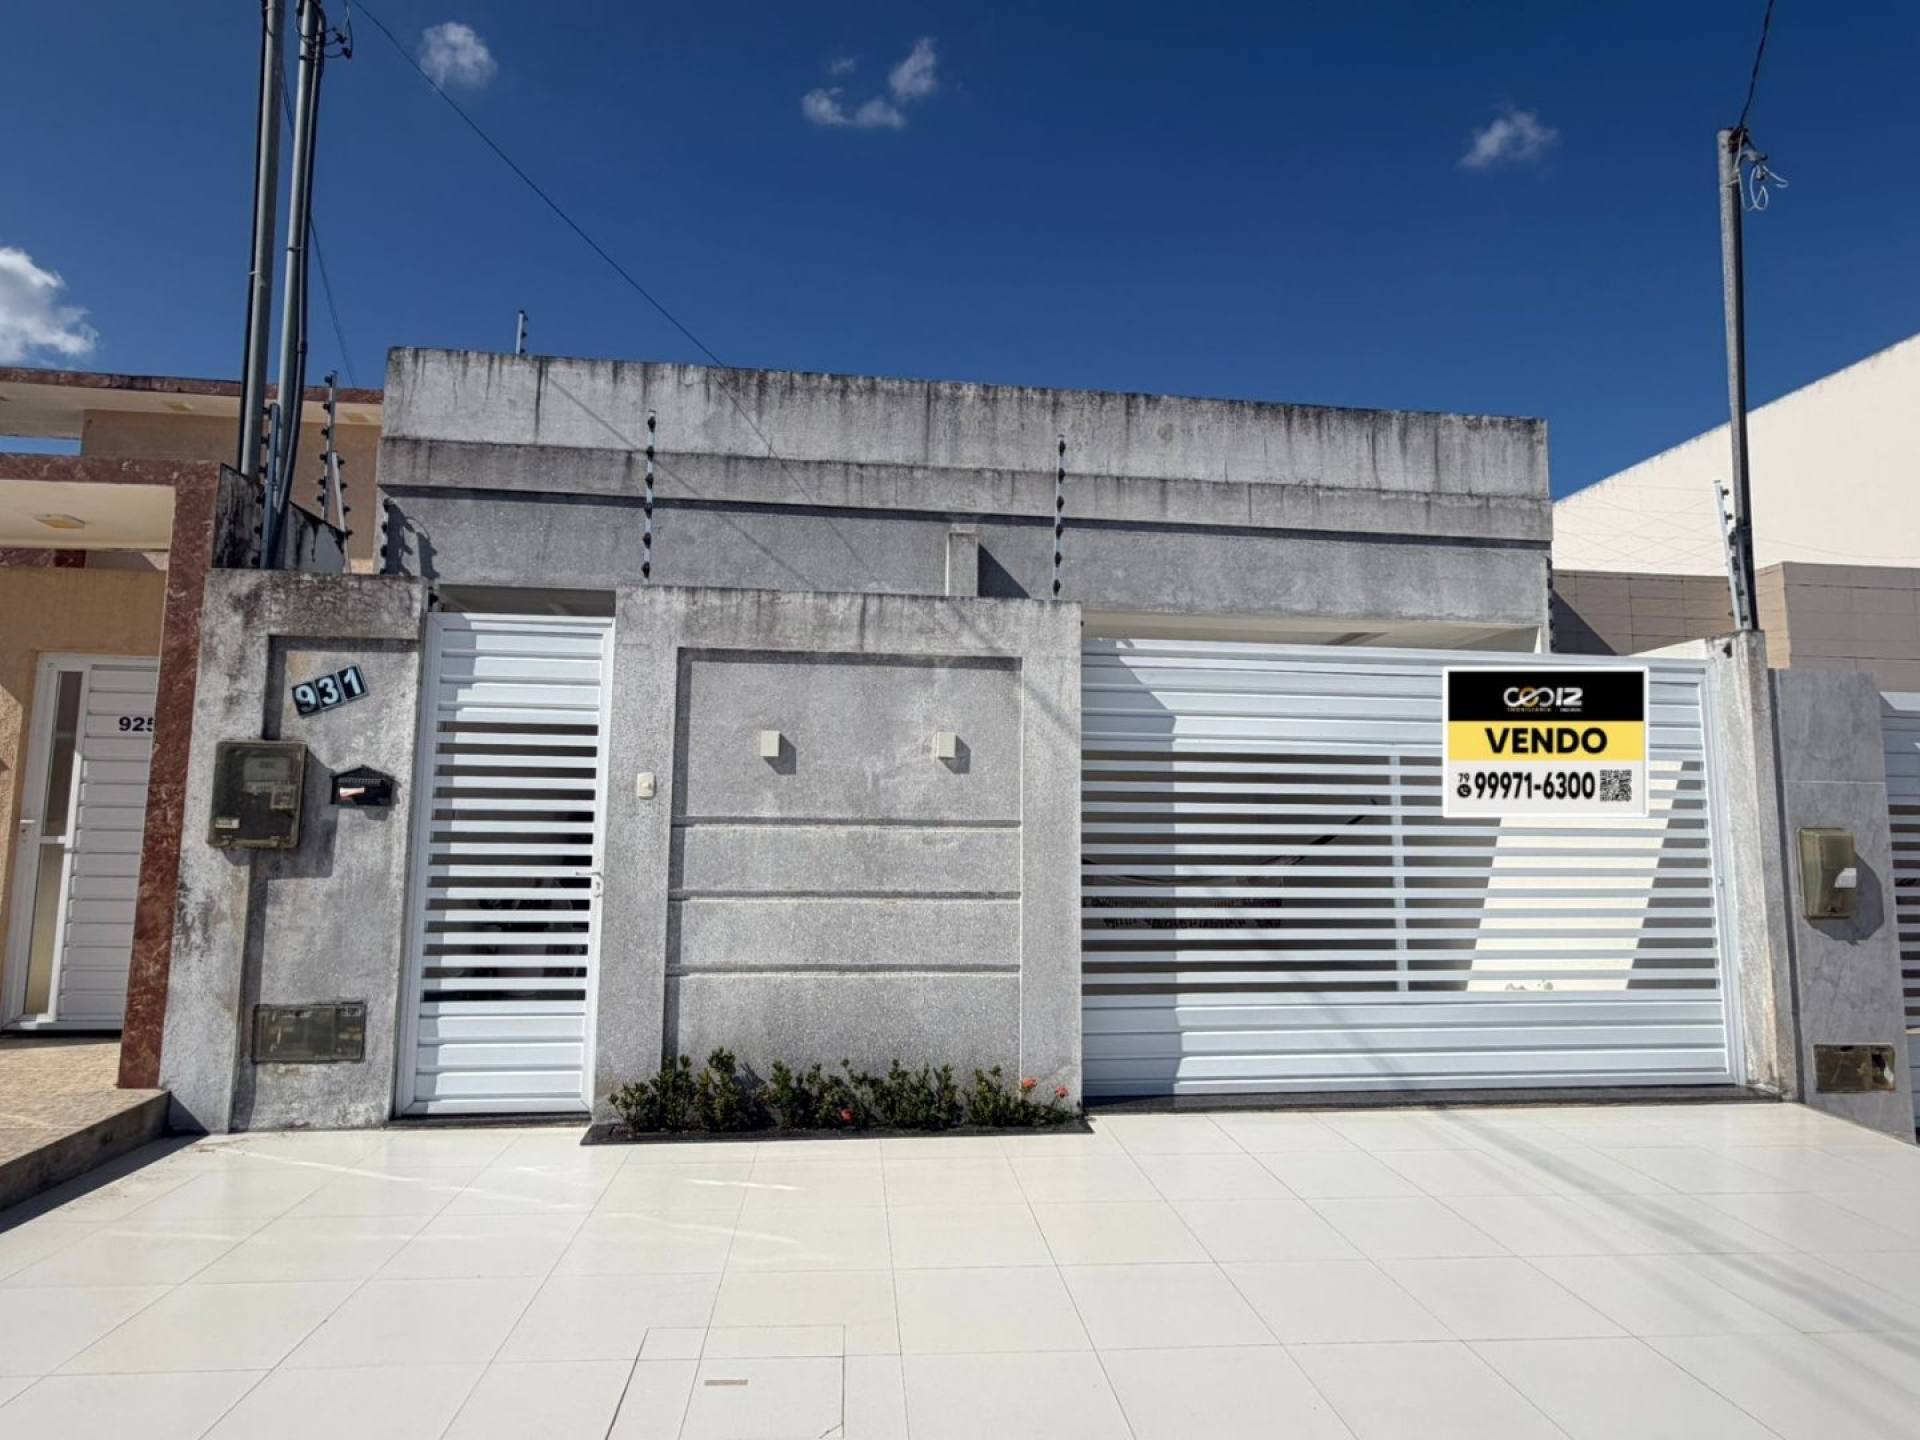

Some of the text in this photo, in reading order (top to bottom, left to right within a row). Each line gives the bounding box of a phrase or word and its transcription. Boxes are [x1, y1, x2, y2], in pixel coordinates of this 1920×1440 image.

[295, 668, 362, 712] 931
[1484, 727, 1608, 754] VENDO
[1458, 772, 1596, 799] 79 99971-6300
